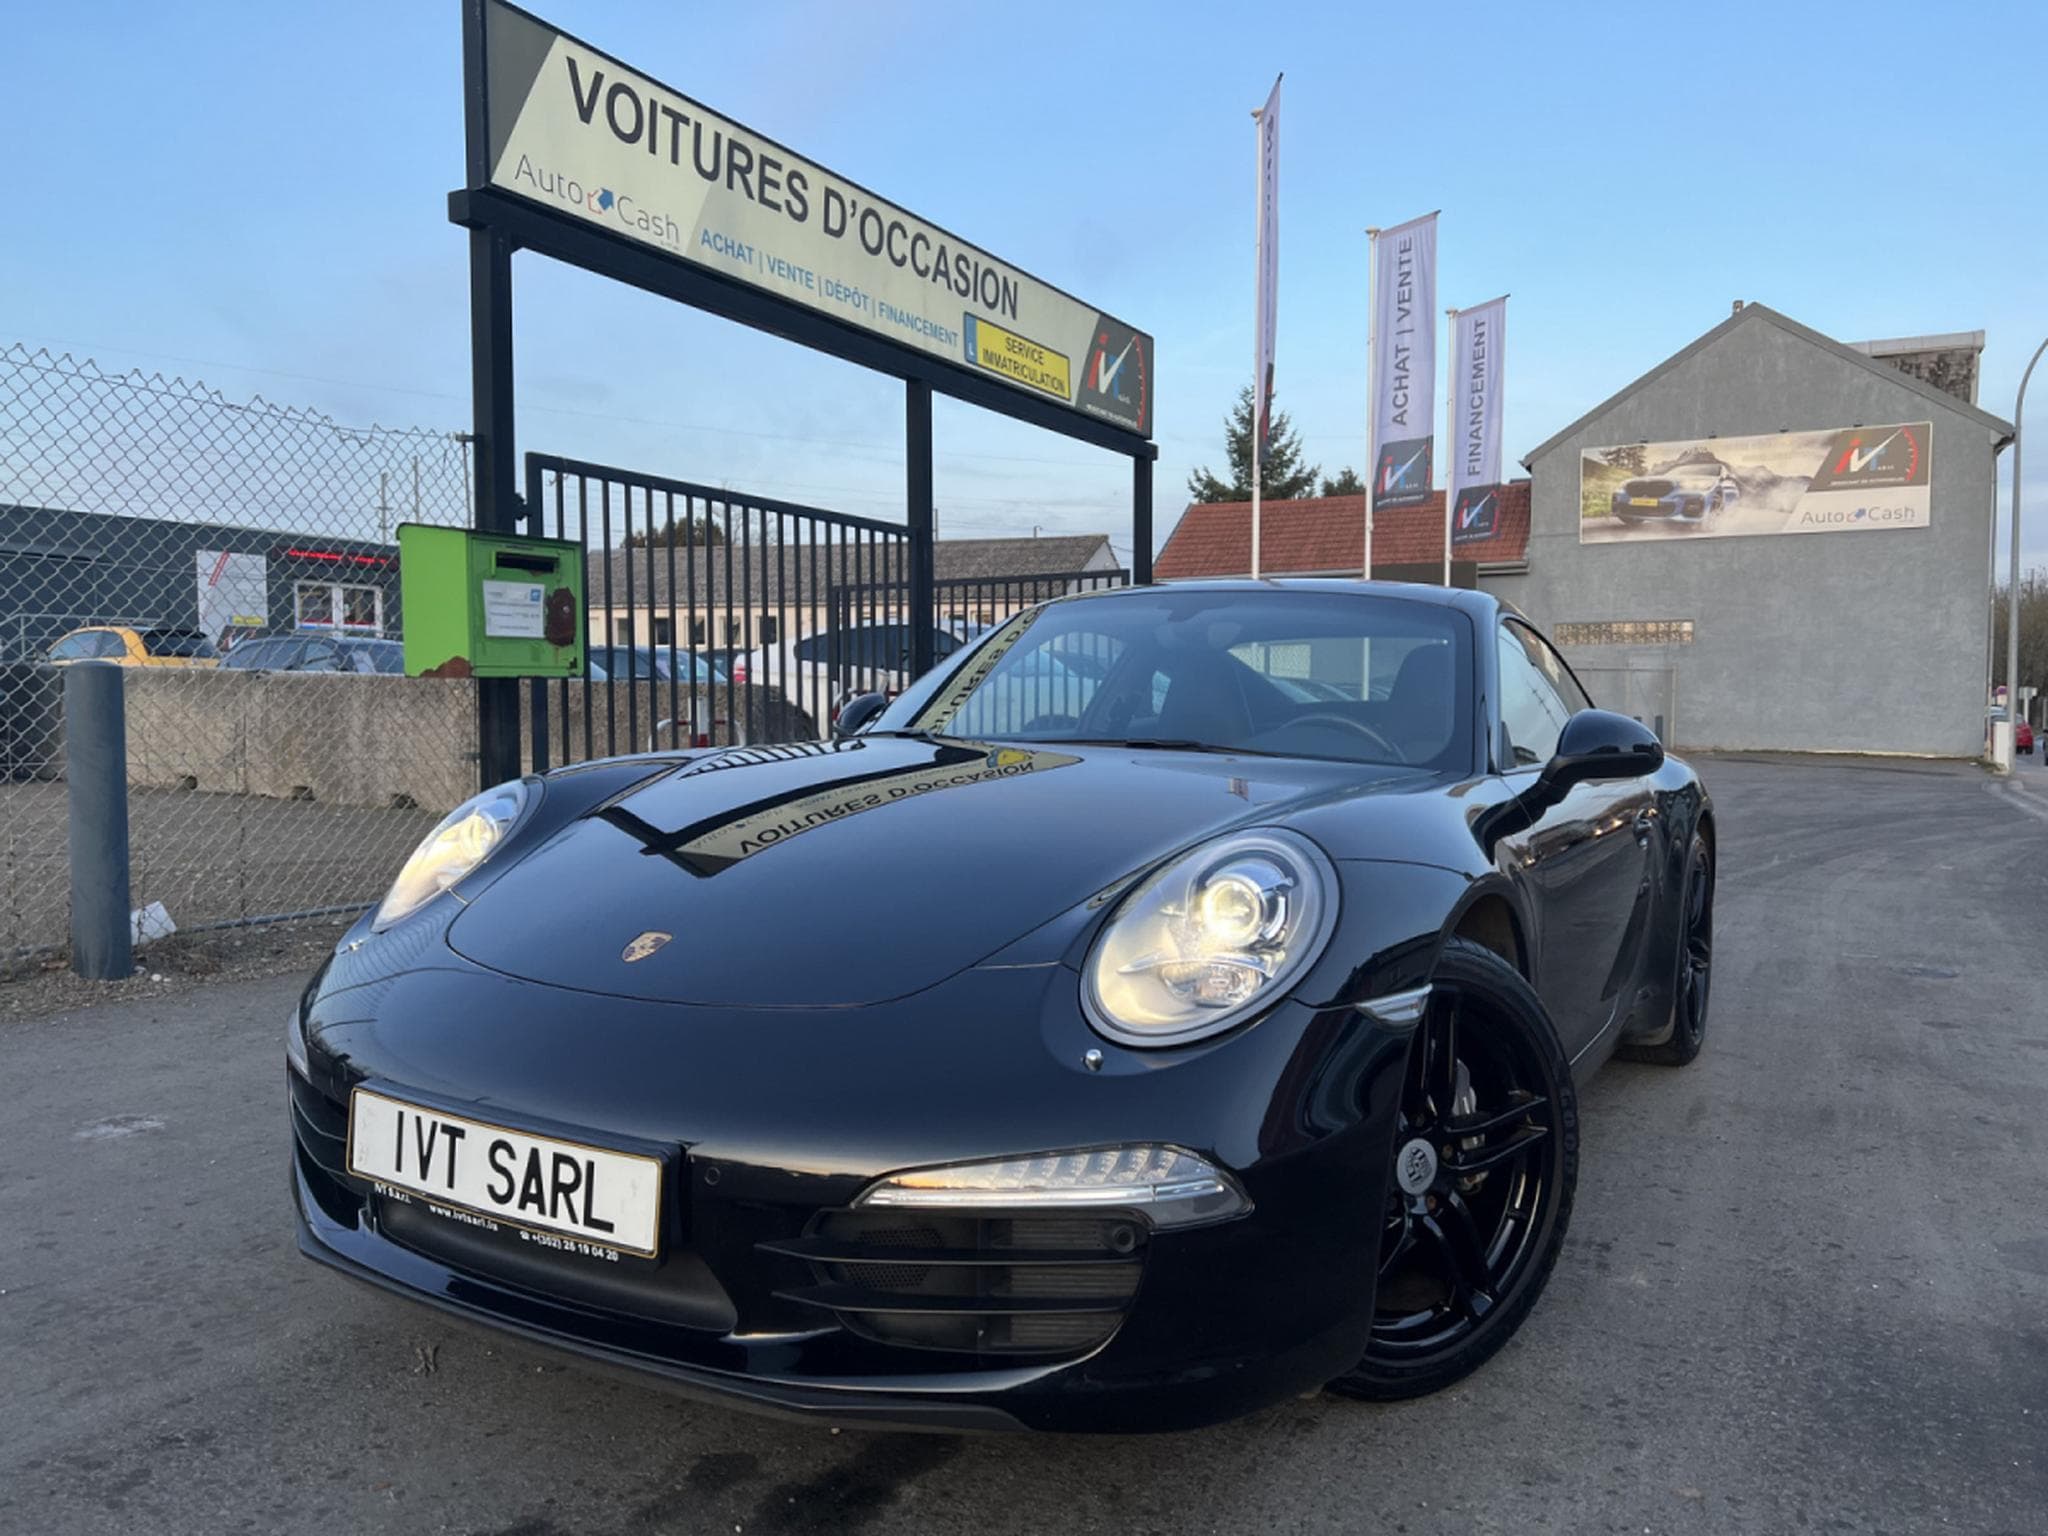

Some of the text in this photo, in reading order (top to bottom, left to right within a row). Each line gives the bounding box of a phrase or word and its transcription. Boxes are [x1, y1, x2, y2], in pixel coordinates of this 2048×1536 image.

[514, 153, 681, 244] Auto Cash
[565, 55, 1019, 321] VOITURES D'OCCASION
[700, 228, 960, 348] ACHAT VENTE DÉPÔT FINANCEMENT
[1390, 235, 1413, 427] ACHAT VENTE
[981, 347, 1067, 394] IMMATRICULATION
[1004, 335, 1046, 366] SERVICE
[1466, 318, 1487, 477] FINANCEMENT
[1799, 505, 1916, 525] Auto Cash
[394, 1110, 615, 1234] IVT SARL
